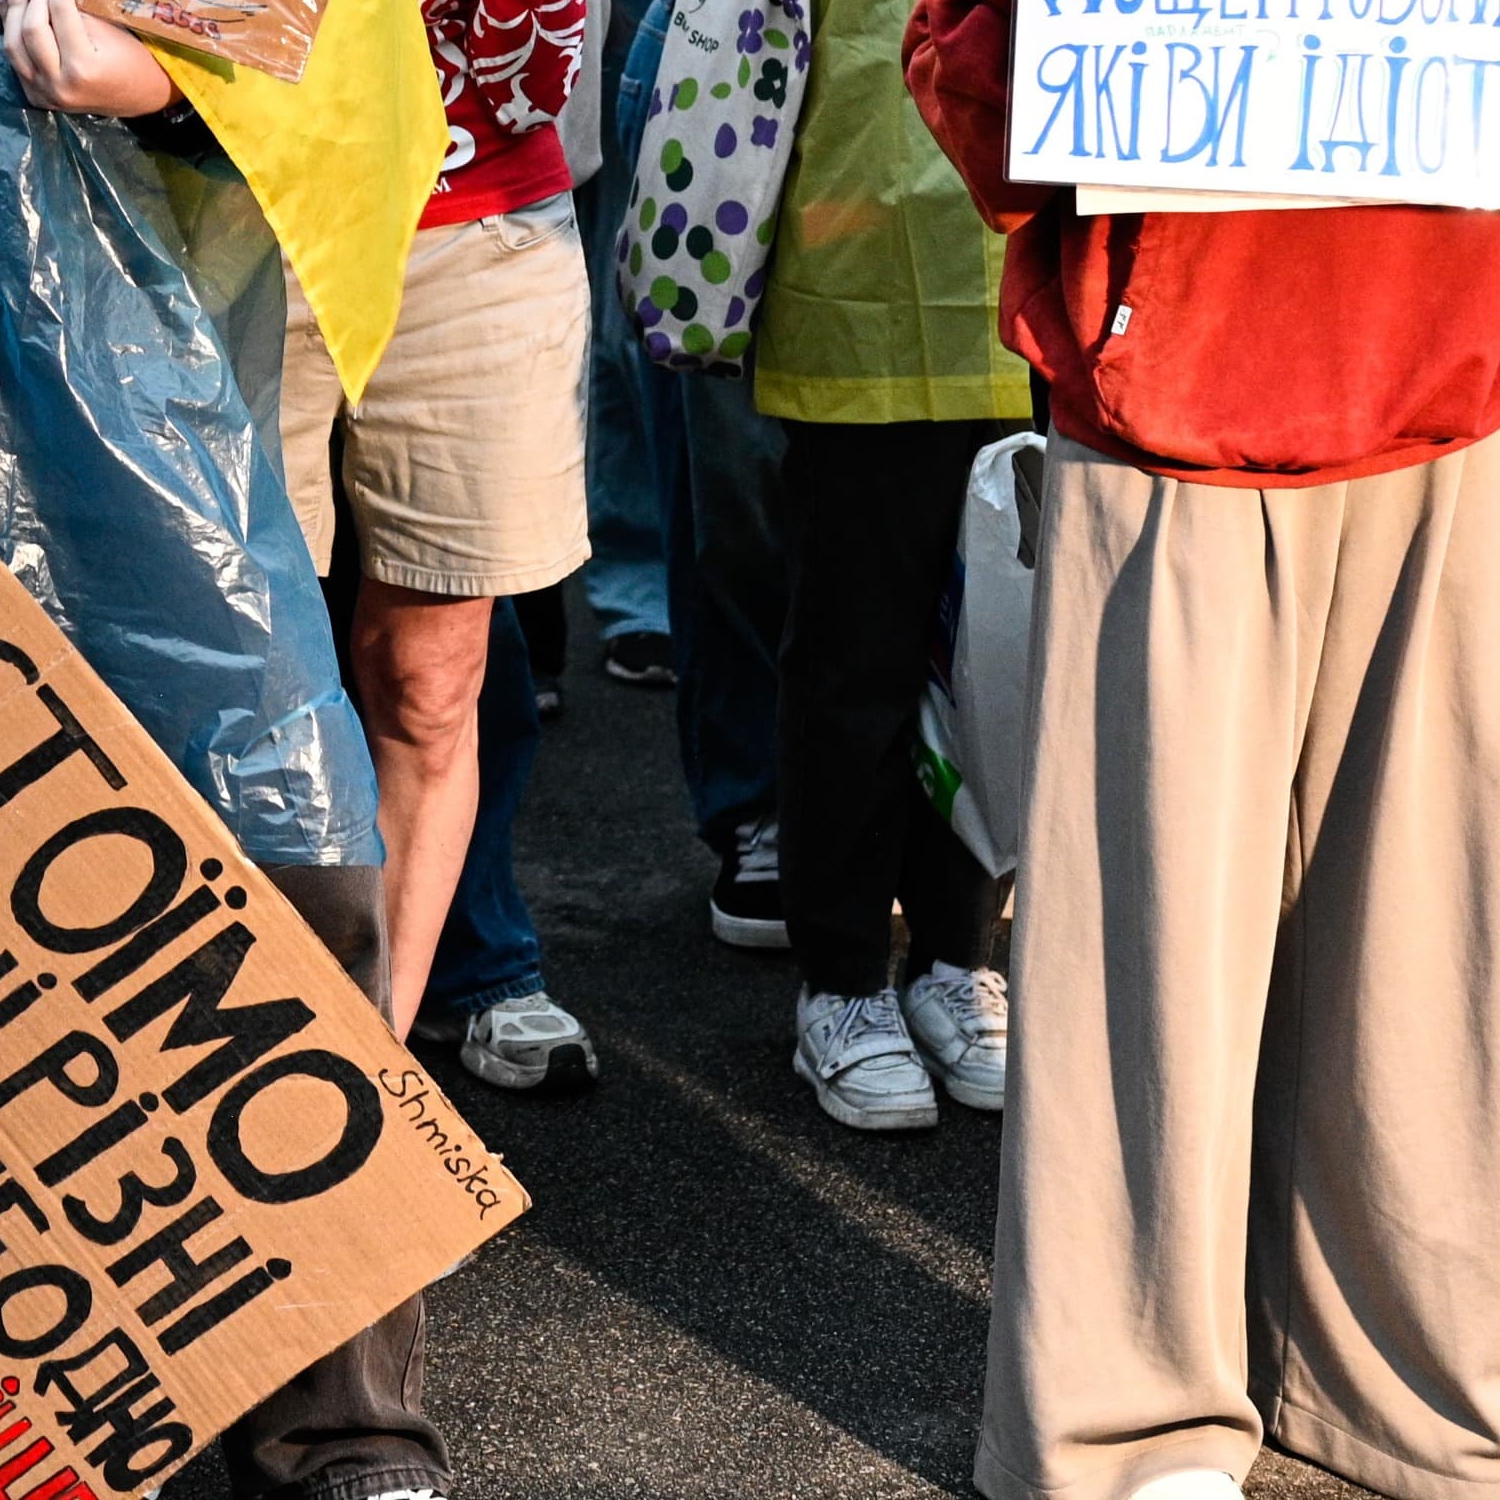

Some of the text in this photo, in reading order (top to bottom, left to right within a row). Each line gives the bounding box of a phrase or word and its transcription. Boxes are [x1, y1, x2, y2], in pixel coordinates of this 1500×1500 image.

[1023, 40, 1147, 162] ЯКІ
[1160, 42, 1259, 168] ВИ
[378, 1068, 501, 1220] Shmiska
